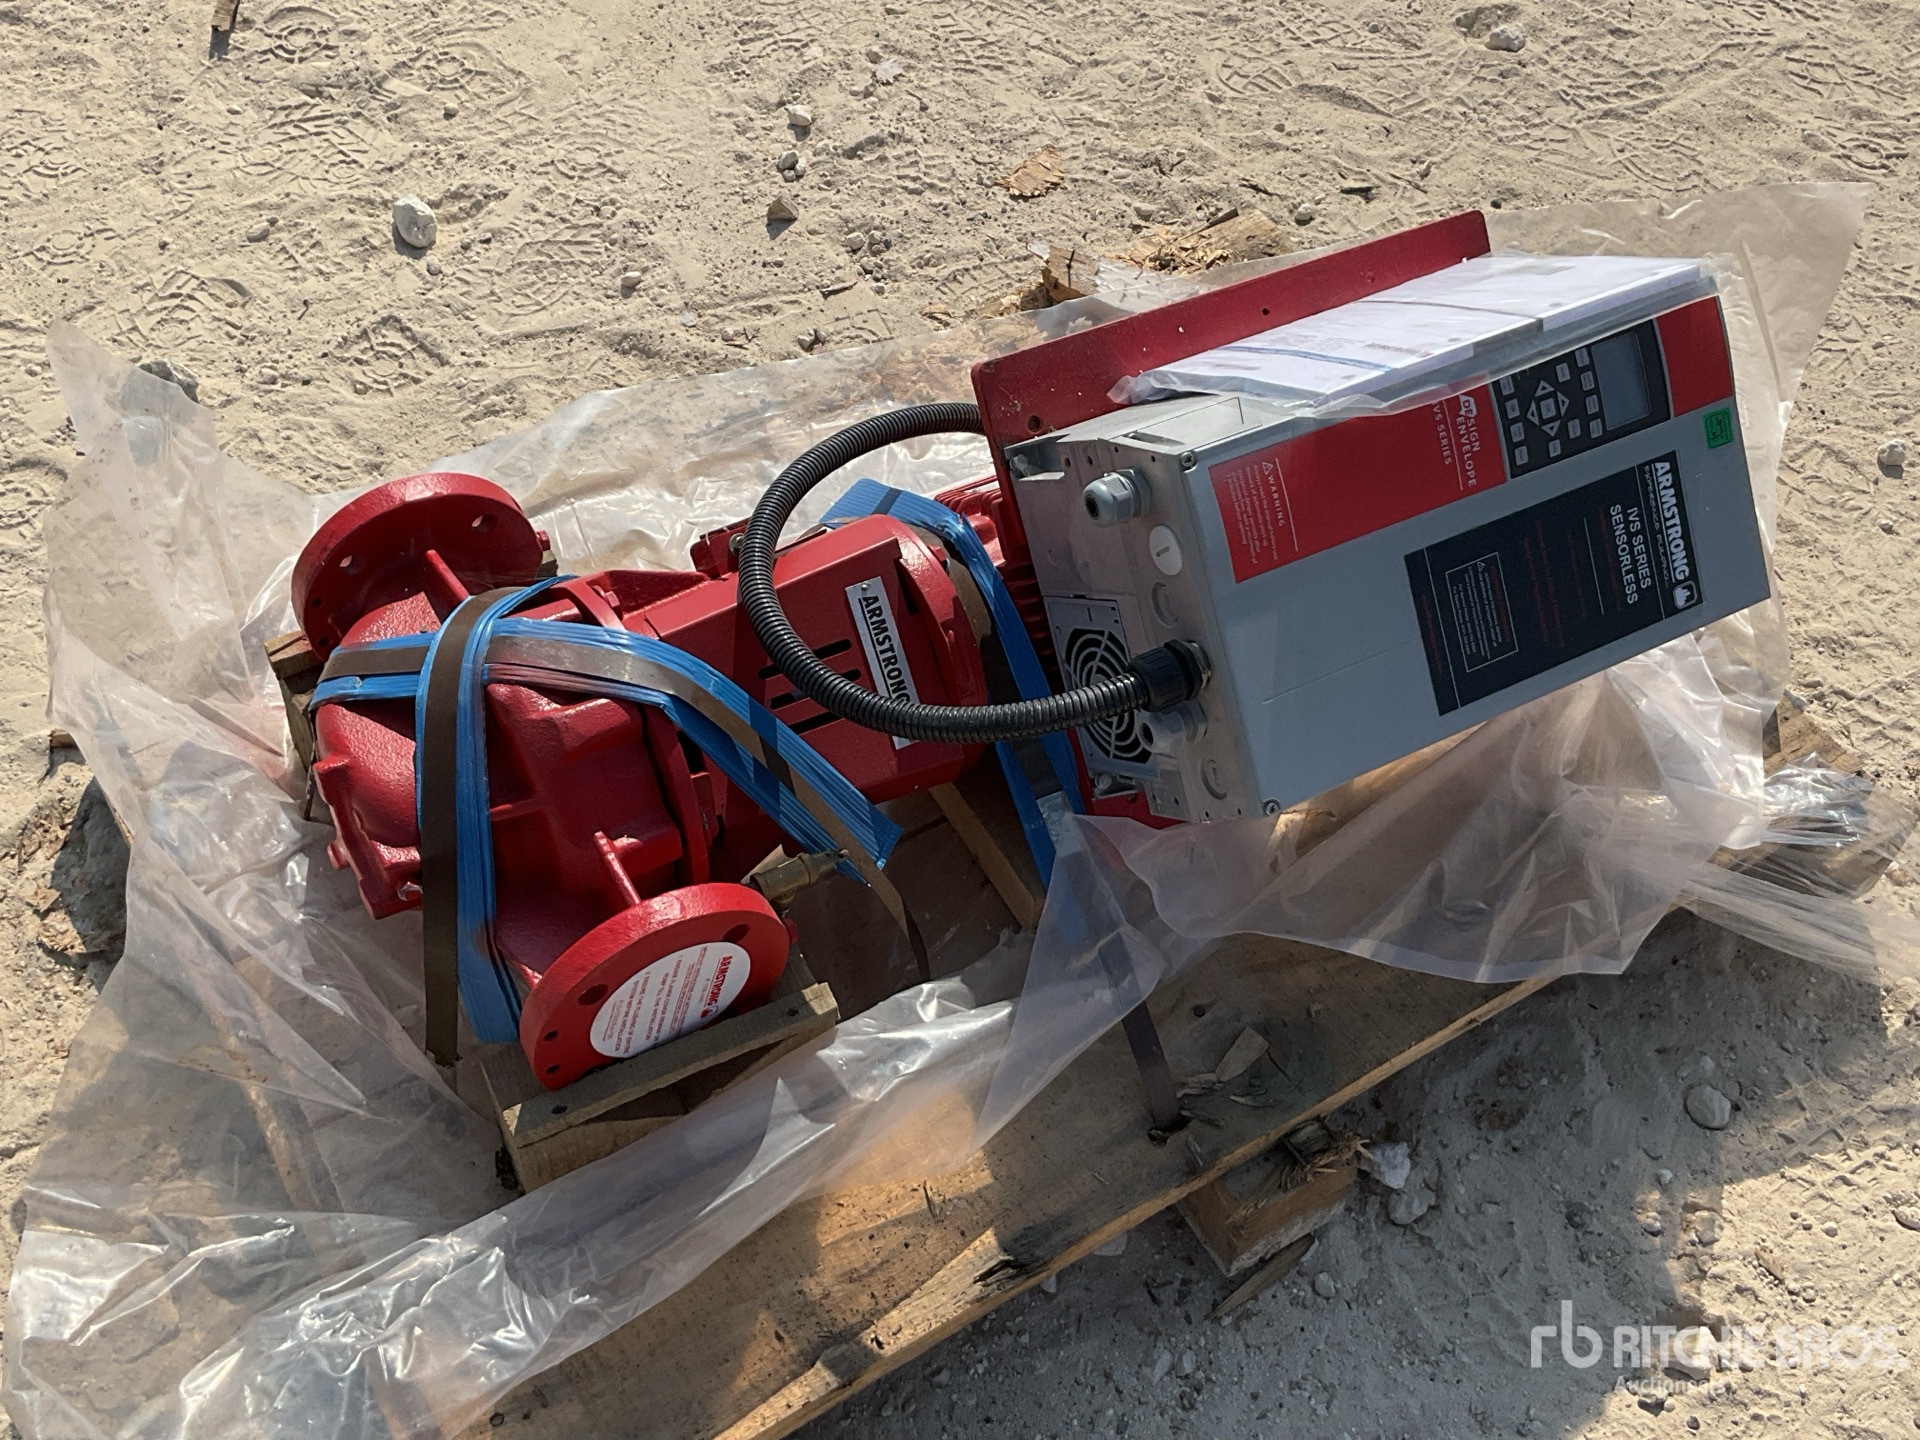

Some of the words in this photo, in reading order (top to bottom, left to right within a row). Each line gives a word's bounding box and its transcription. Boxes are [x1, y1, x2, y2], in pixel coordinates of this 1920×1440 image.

[1437, 424, 1452, 465] SERIES
[1456, 416, 1477, 487] ENVELOPE
[1462, 399, 1480, 451] DESIGN
[1268, 474, 1285, 527] WARNING
[1627, 507, 1641, 532] IVS
[1644, 465, 1660, 531] EXPERIENCE
[1655, 461, 1690, 580] ARMSTRONG
[1610, 504, 1639, 605] SENSORLESS
[1632, 534, 1652, 589] SERIES
[707, 955, 733, 1006] ARMSTRONG
